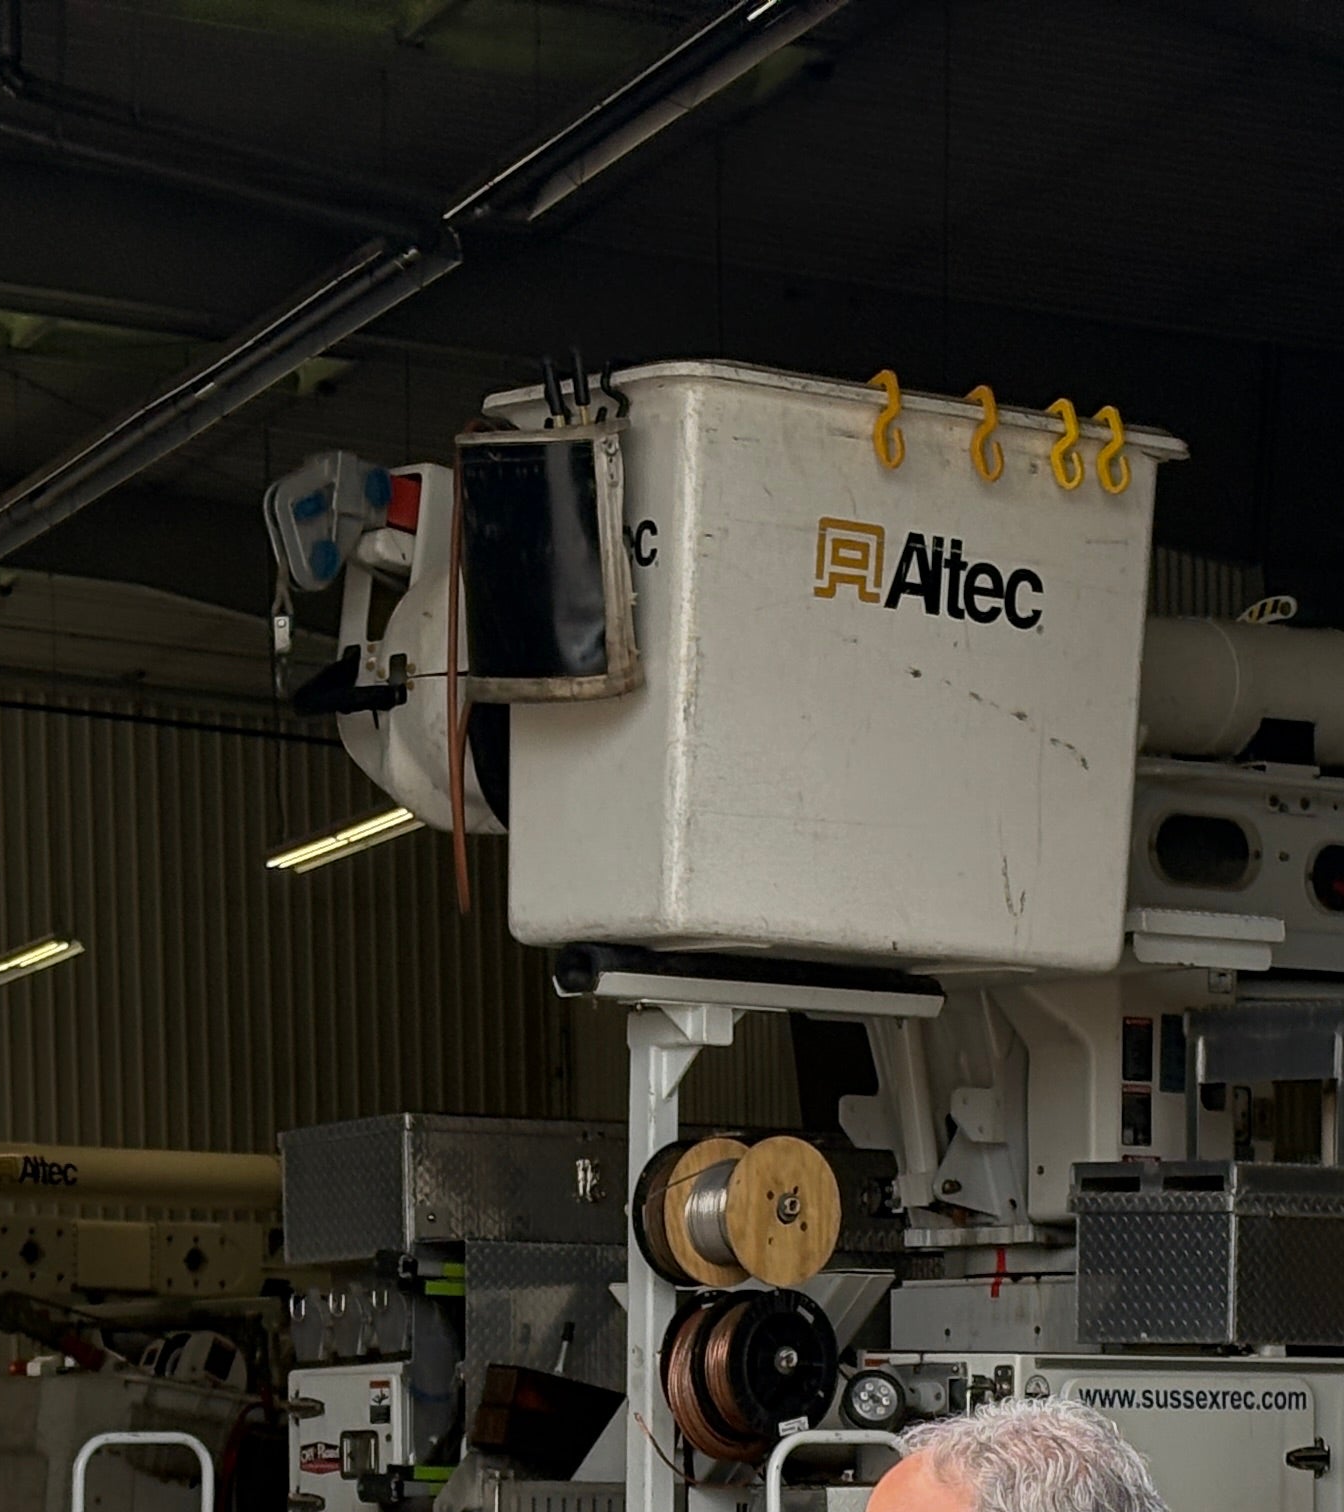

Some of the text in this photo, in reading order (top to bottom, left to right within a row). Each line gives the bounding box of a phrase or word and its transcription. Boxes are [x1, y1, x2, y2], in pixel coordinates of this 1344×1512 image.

[884, 531, 1044, 630] Altec
[18, 1155, 78, 1185] Altec
[1078, 1388, 1308, 1411] www.sussexrec.com
